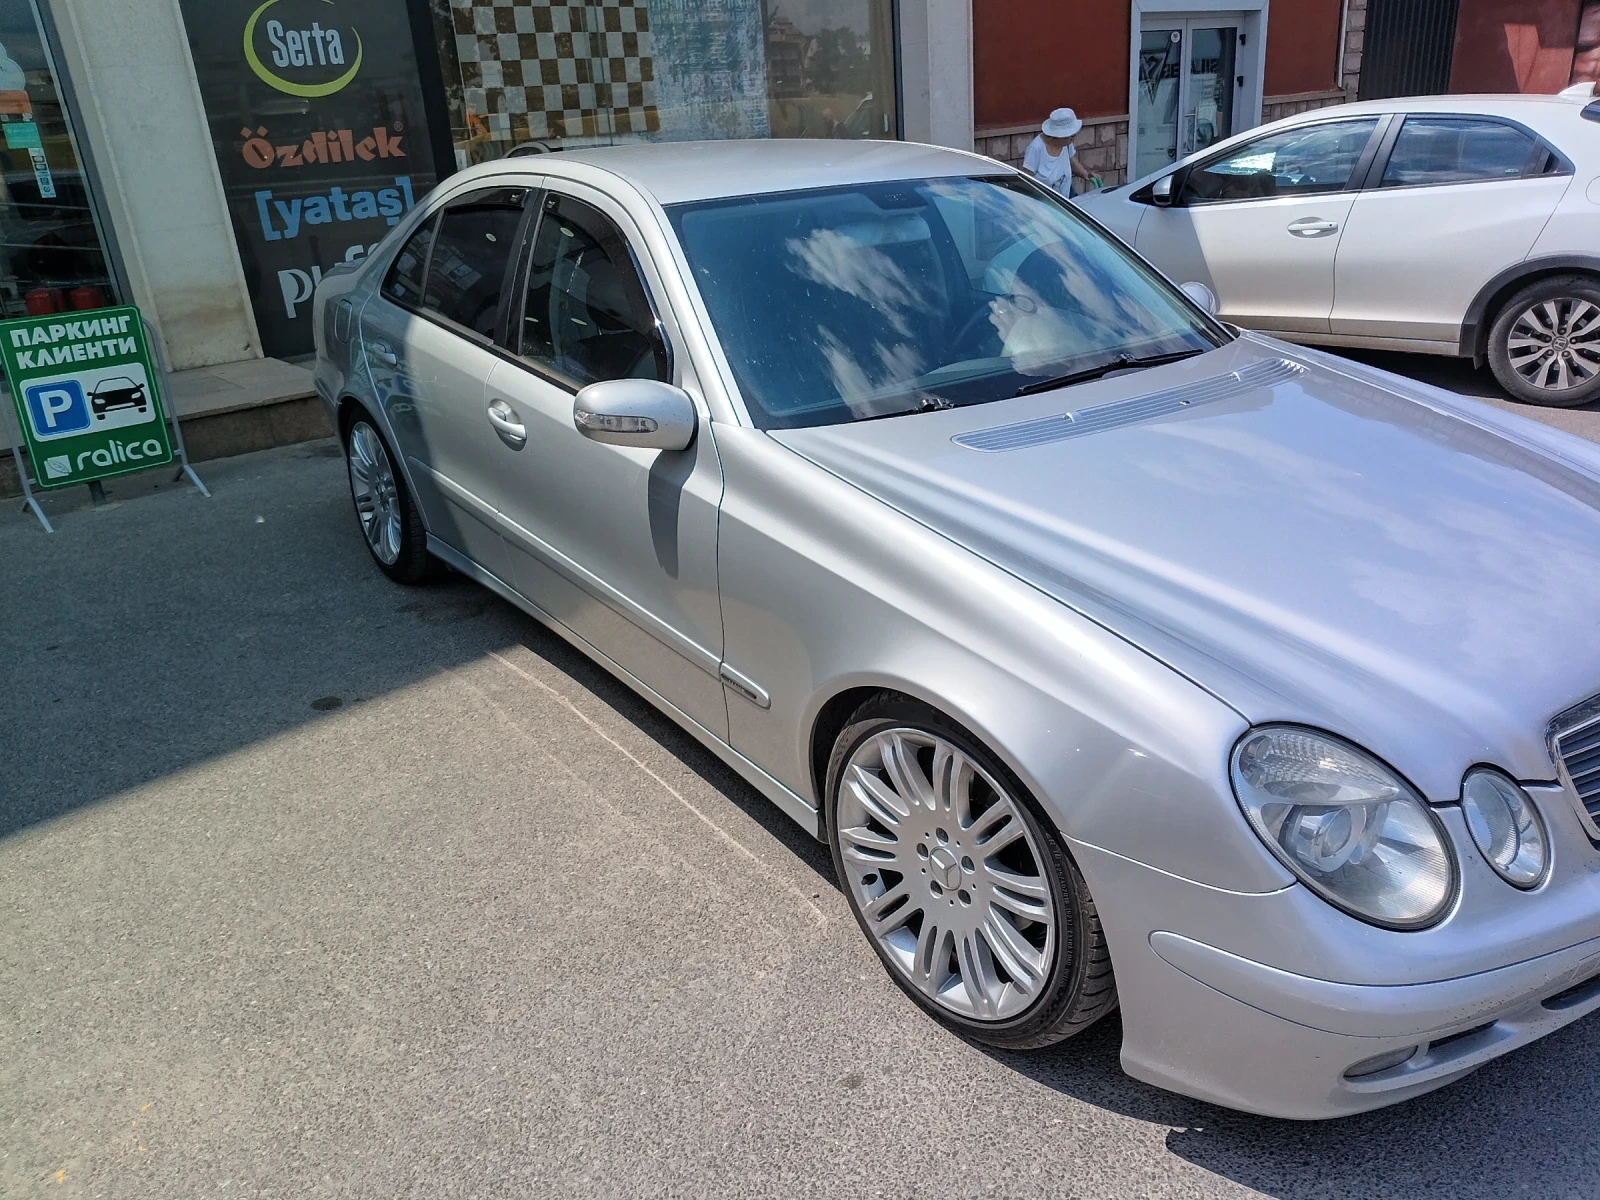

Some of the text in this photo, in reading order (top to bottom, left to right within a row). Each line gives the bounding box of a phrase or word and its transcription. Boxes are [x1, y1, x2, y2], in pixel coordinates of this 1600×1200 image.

[266, 19, 345, 68] Serta
[9, 315, 131, 348] ПАРКИНГ
[15, 336, 138, 370] КЛИЕНТИ
[39, 389, 73, 428] P
[77, 438, 163, 471] ralica
